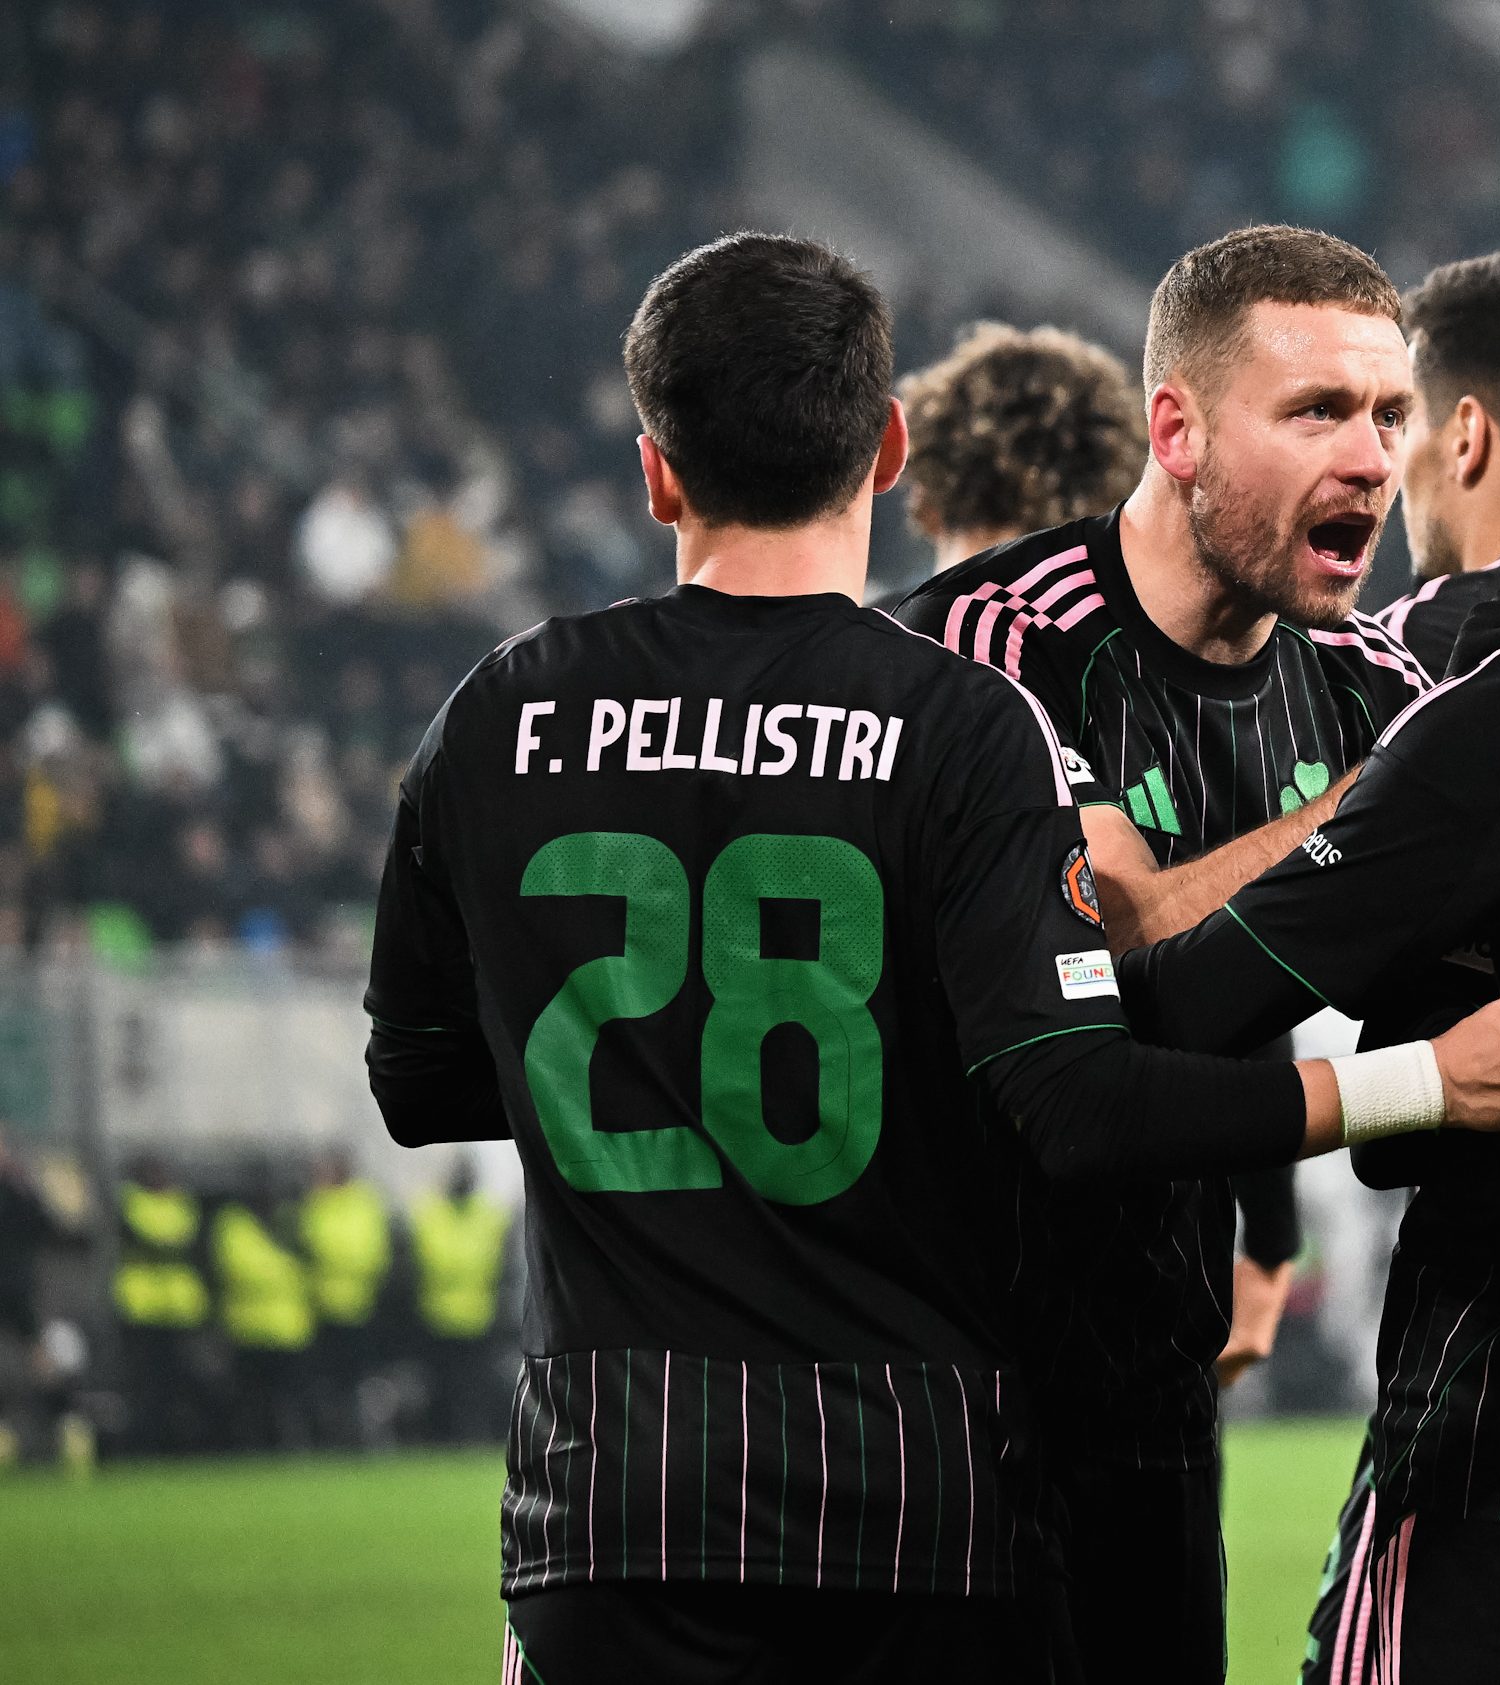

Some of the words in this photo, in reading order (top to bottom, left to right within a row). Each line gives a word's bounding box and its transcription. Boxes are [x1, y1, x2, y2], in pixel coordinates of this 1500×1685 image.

[514, 700, 563, 774] F.
[586, 697, 904, 781] PELLISTRI
[1060, 956, 1084, 966] UEFA
[519, 831, 885, 1206] 28
